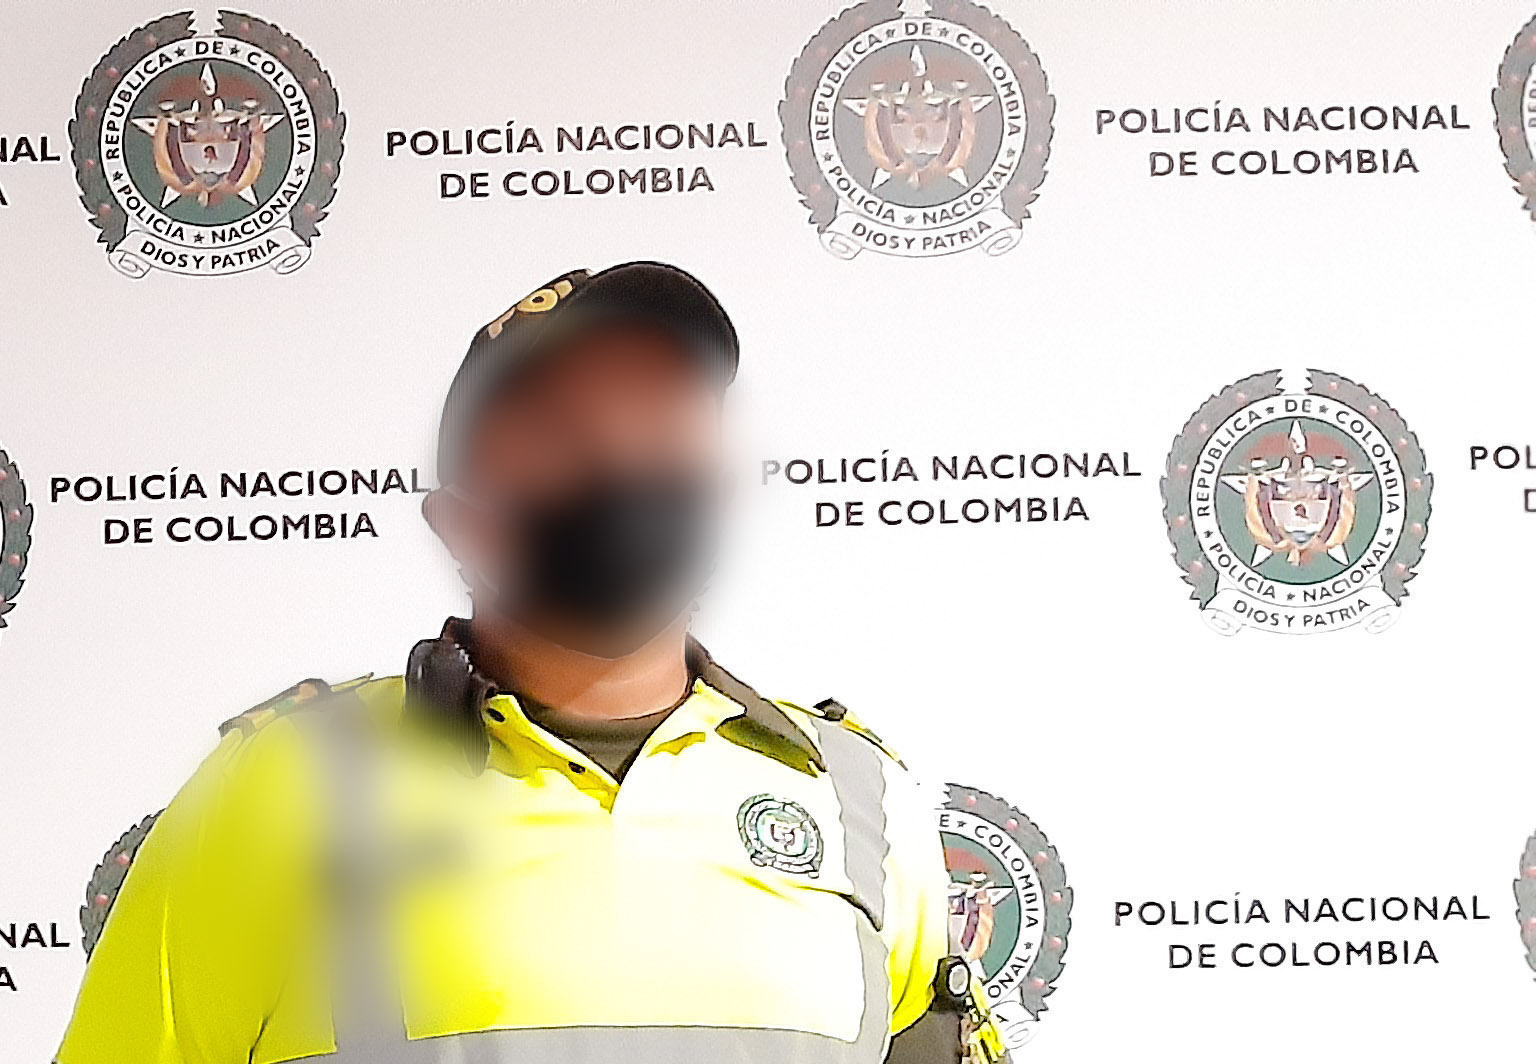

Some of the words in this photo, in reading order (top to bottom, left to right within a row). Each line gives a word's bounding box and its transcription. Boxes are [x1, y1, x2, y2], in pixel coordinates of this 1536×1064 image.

[1096, 100, 1251, 134] POLICÍA
[1264, 105, 1470, 132] NACIONAL
[387, 121, 543, 156] POLICÍA
[557, 122, 767, 152] NACIONAL
[1150, 151, 1198, 177] DE
[1212, 148, 1419, 175] COLOMBIA
[441, 173, 489, 198] DE
[503, 167, 714, 196] COLOMBIA
[762, 449, 919, 485] POLICÍA
[933, 452, 1141, 481] NACIONAL
[51, 467, 207, 502] POLICÍA
[221, 468, 432, 498] NACIONAL
[816, 502, 864, 527] DE
[878, 497, 1089, 525] COLOMBIA
[105, 518, 153, 544] DE
[167, 513, 379, 542] COLOMBIA
[1115, 892, 1270, 926] POLICÍA
[1285, 895, 1490, 923] NACIONAL
[1169, 944, 1216, 968] DE
[1232, 940, 1439, 967] COLOMBIA
